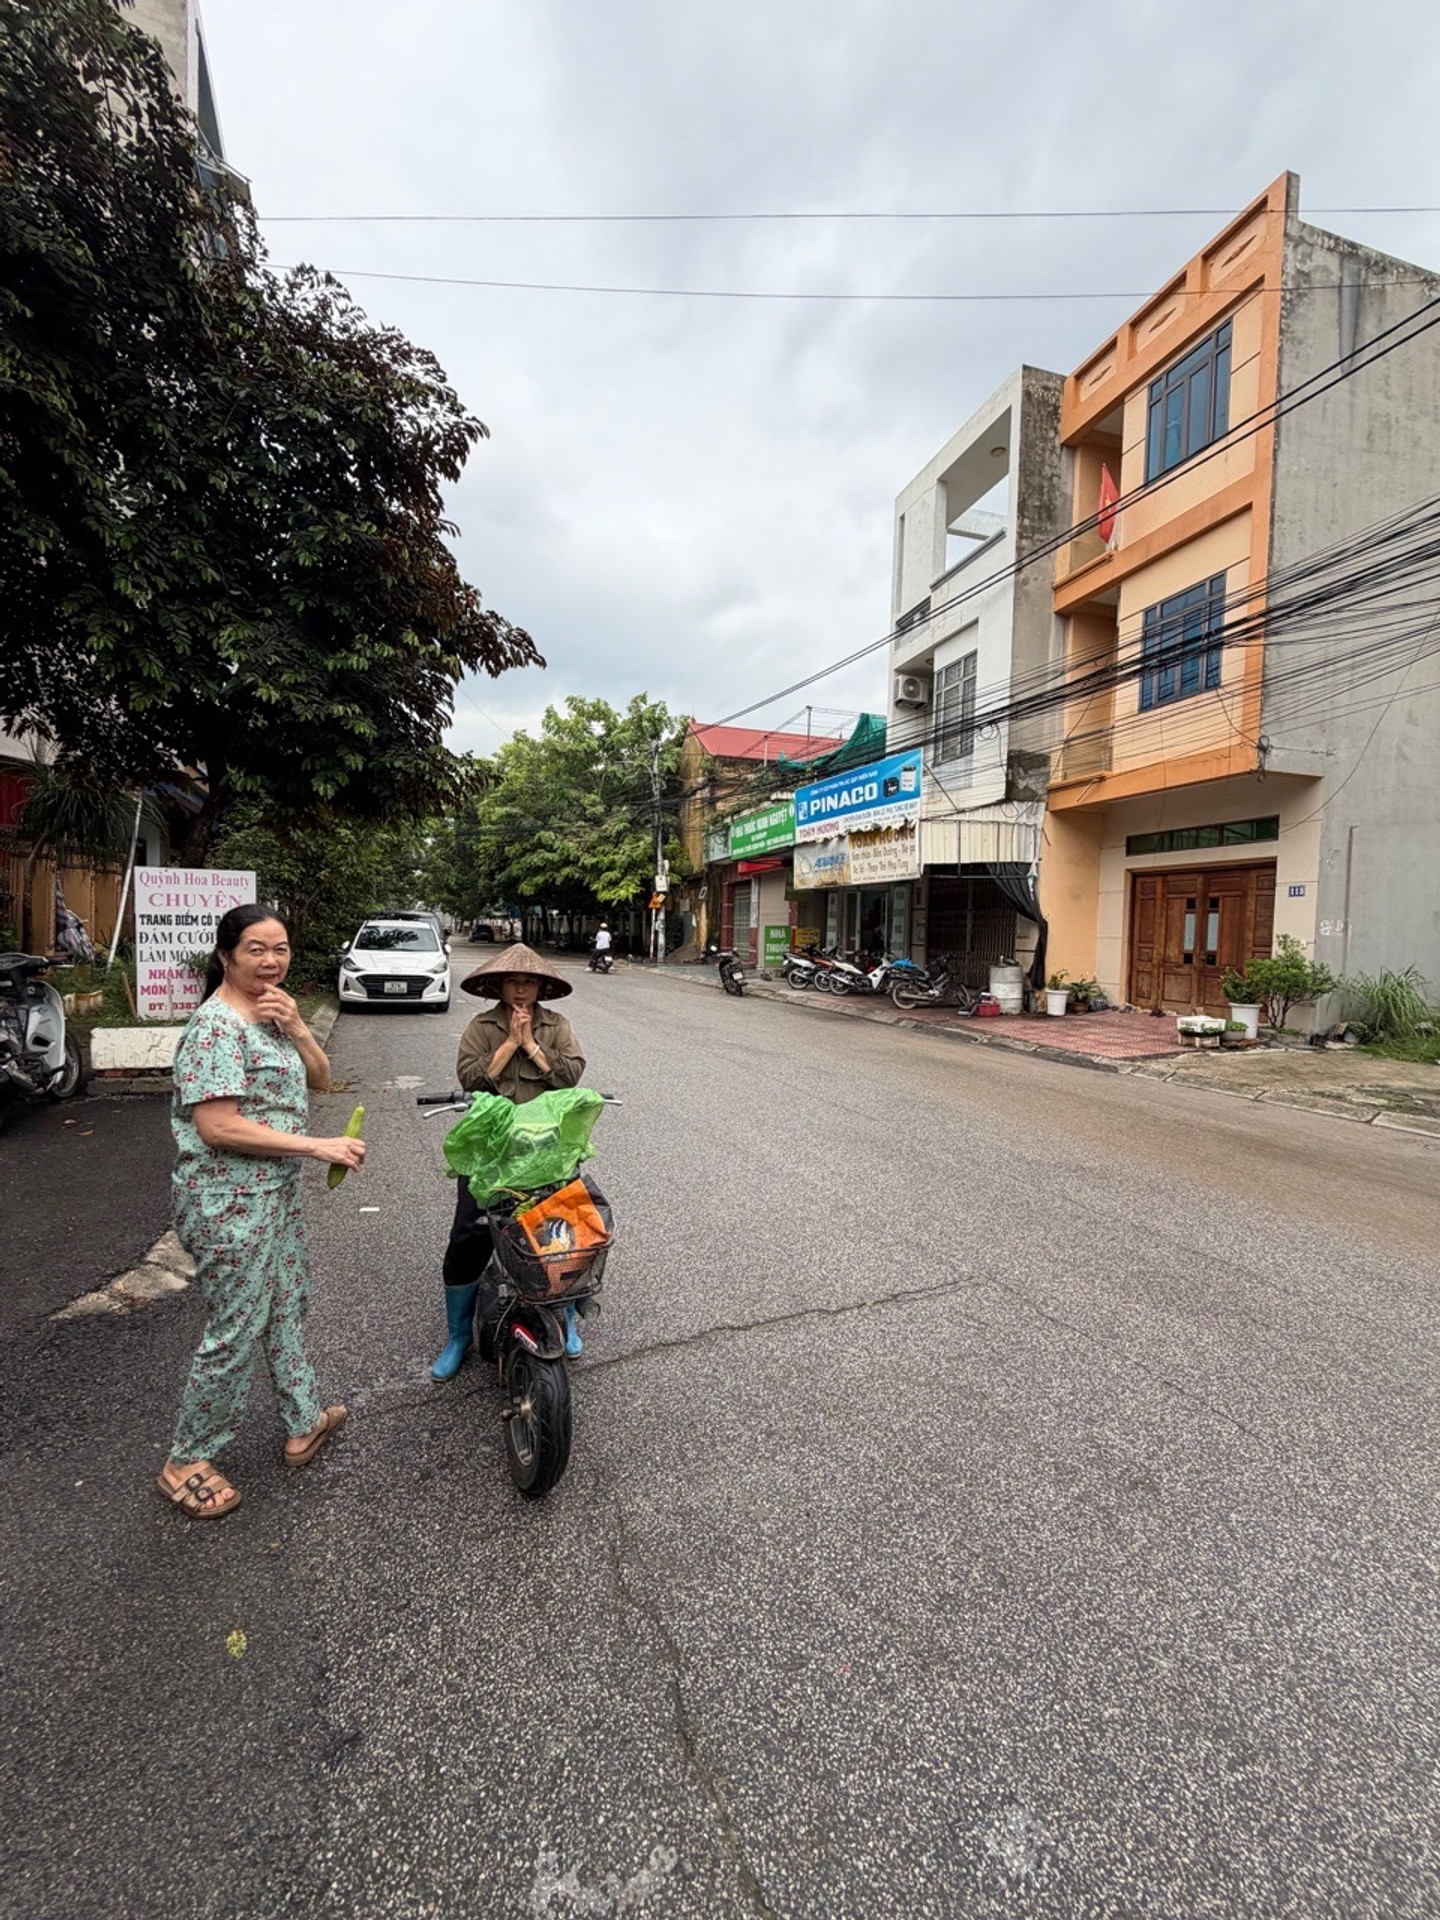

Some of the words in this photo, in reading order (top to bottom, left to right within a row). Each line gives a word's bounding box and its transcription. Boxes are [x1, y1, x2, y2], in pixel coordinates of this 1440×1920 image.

[810, 782, 879, 816] PINACO
[184, 872, 208, 886] Hoa
[212, 873, 249, 890] Beauty
[148, 890, 242, 908] CHUYÊN
[140, 914, 172, 926] TRANG
[139, 927, 173, 944] ĐÁM
[139, 946, 166, 962] LÀM
